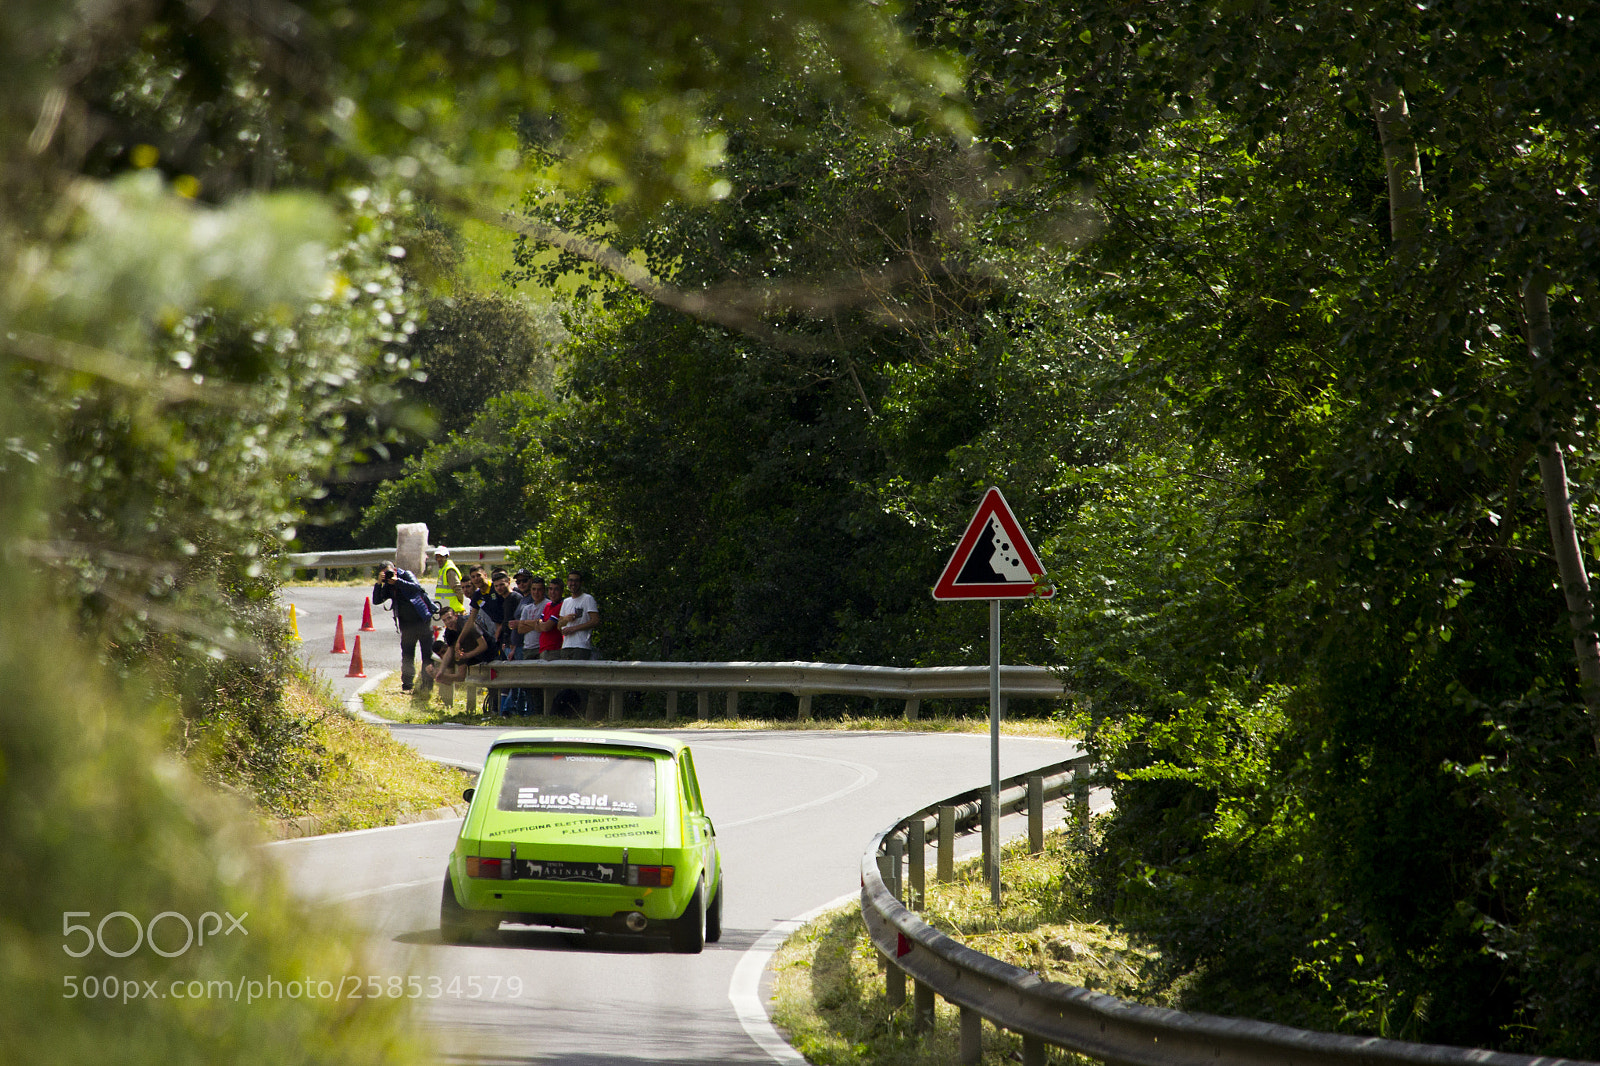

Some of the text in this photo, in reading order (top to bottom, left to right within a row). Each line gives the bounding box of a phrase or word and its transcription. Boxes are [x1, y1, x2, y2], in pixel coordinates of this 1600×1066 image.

[489, 817, 619, 838] AUTOFFICINA ELETTRAUTO
[591, 823, 639, 831] CARBONI
[604, 830, 661, 839] COSSOINE
[544, 866, 594, 877] ASINARA
